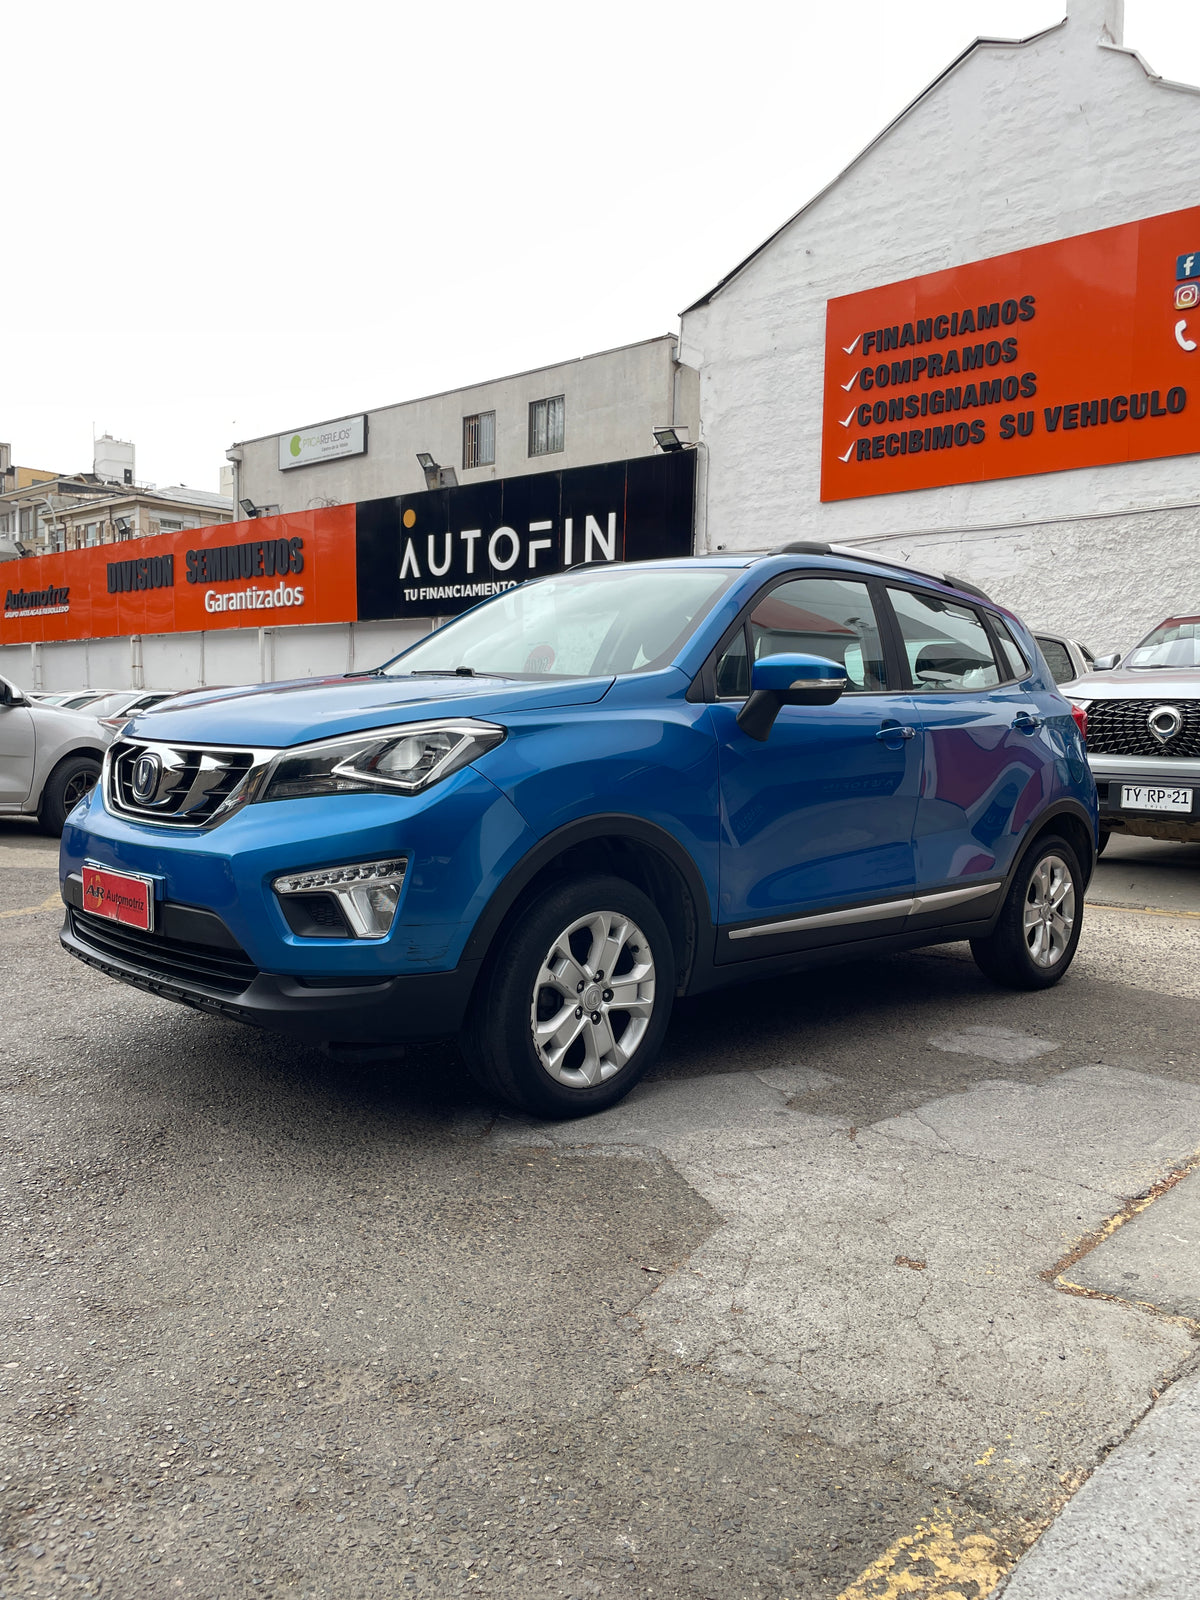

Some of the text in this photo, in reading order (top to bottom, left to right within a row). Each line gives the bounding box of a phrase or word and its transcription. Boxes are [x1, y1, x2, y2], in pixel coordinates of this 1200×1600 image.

[862, 296, 1036, 355] FINANCIAMOS
[859, 338, 1018, 391] COMPRAMOS
[856, 386, 1187, 461] RECIBIMOS SU VEHICULO
[857, 373, 1037, 427] CONSIGNAMOS
[106, 537, 304, 593] DIVISION SEMINUEVOS
[399, 509, 617, 579] AUTOFIN
[4, 584, 70, 610] Automotriz
[205, 582, 304, 613] Garantizados
[404, 588, 419, 601] TU
[106, 890, 144, 911] Automotriz
